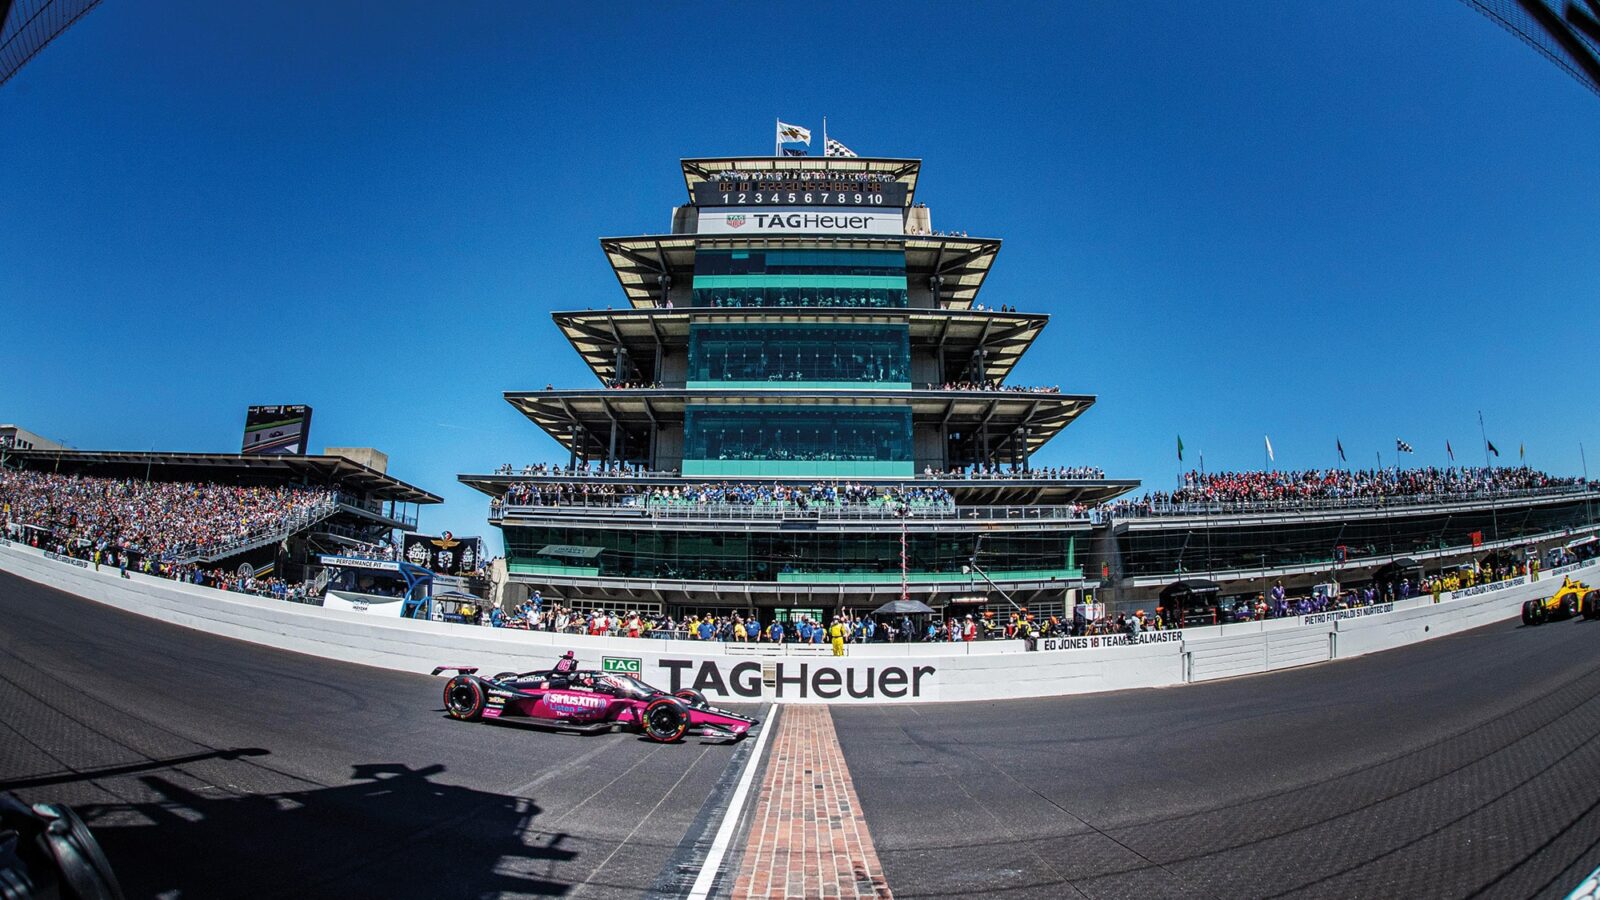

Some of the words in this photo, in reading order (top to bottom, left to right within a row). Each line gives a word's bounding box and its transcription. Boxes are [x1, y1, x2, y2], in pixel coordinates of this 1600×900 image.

[722, 194, 729, 204] 1
[738, 193, 746, 204] 2
[755, 193, 763, 203] 3
[771, 193, 780, 203] 4
[788, 193, 796, 203] 5
[804, 193, 813, 203] 6
[821, 193, 830, 203] 7
[838, 193, 846, 203] 8
[854, 194, 862, 204] 9
[867, 194, 883, 204] 10
[408, 551, 426, 560] 500
[336, 558, 372, 567] PERFORMANCE
[1304, 614, 1325, 625] PIETRO
[1326, 609, 1355, 621] FITTIPALDI
[1363, 606, 1383, 616] NURTEC
[1044, 639, 1056, 651] ED
[1058, 638, 1088, 650] JONES
[1090, 637, 1100, 648] 18
[1102, 635, 1126, 647] TEAM
[605, 660, 638, 671] TAG
[516, 675, 547, 683] HONDA
[549, 703, 575, 713] Listen
